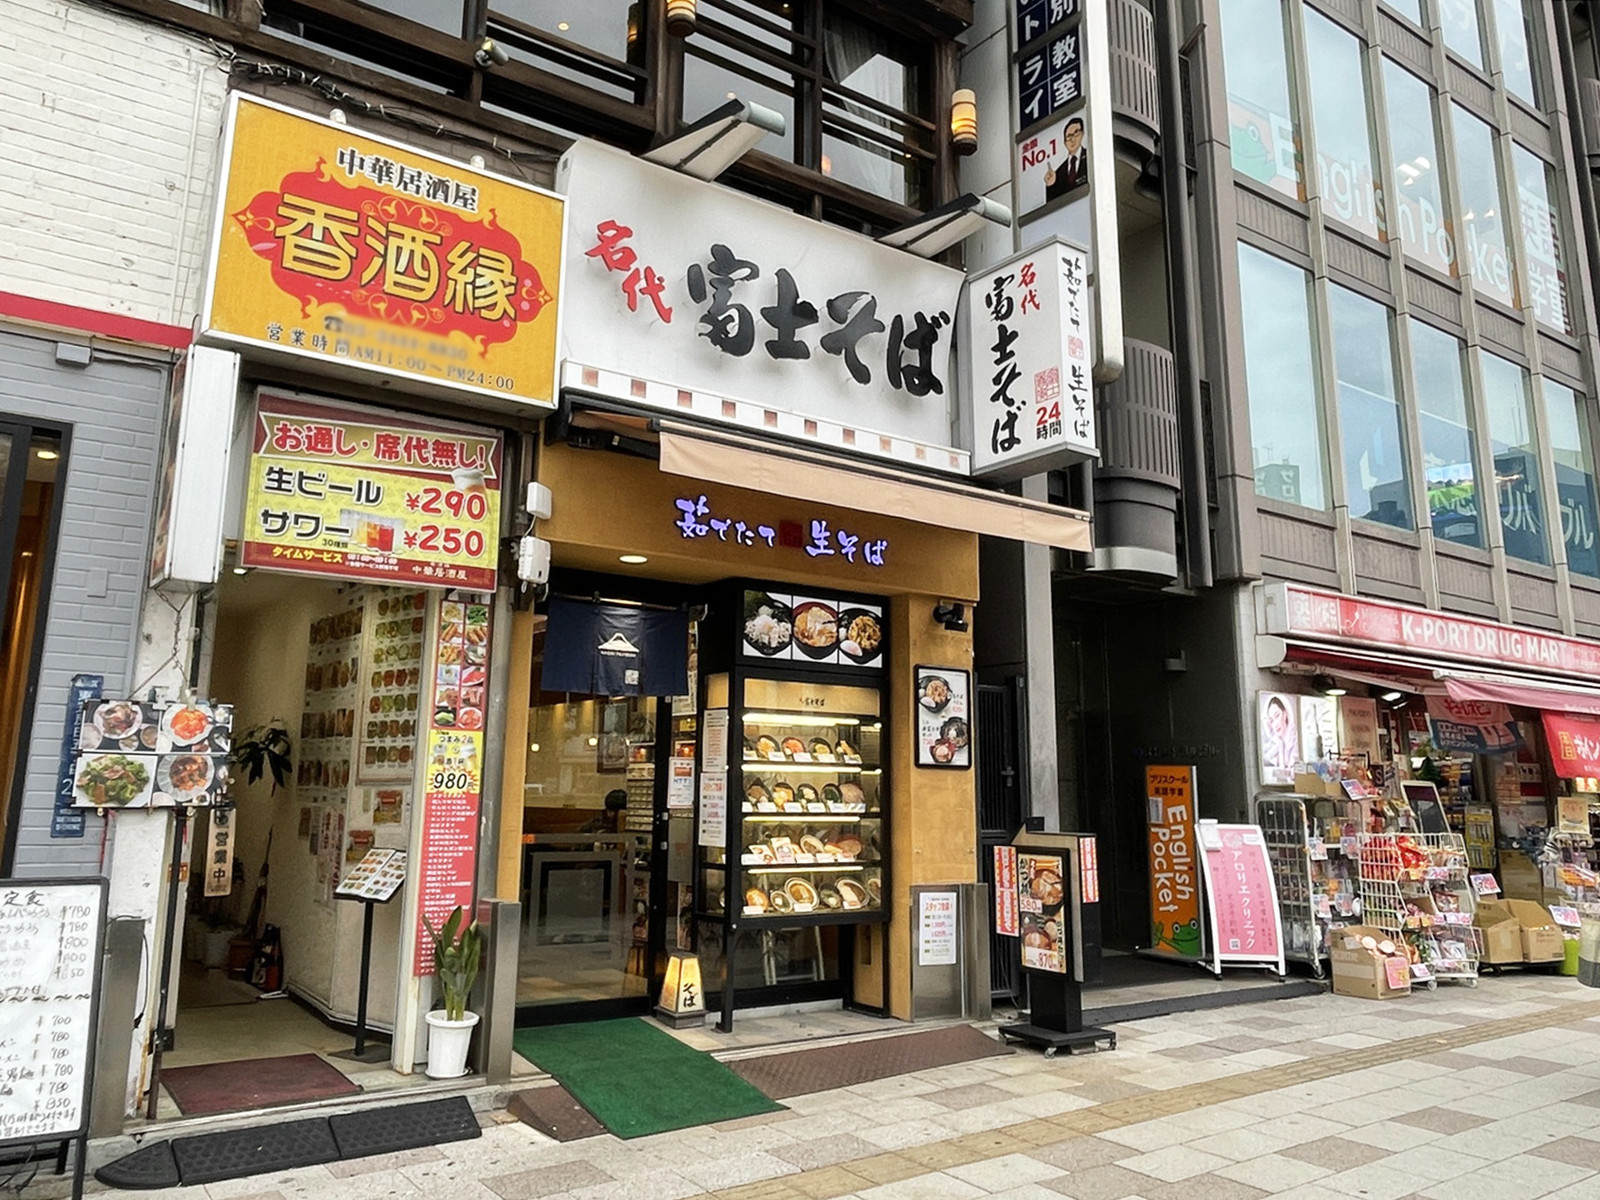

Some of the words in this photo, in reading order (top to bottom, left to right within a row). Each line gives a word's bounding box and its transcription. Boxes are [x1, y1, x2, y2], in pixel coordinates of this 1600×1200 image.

[1022, 0, 1043, 119] トライ
[1022, 139, 1056, 171] No.1
[337, 147, 480, 213] 中華居酒屋
[274, 193, 518, 321] 香酒縁
[584, 219, 673, 324] 名代
[686, 243, 951, 397] 富士そば
[1018, 262, 1041, 315] 名代
[985, 274, 1027, 455] 富士そば
[1036, 401, 1061, 427] 24
[1068, 364, 1090, 439] 生そば
[1036, 419, 1062, 440] 時間
[263, 465, 384, 507] 生ビール
[405, 487, 487, 522] ¥290
[260, 508, 352, 540] サワー
[403, 523, 485, 558] ¥250
[806, 520, 887, 565] 生そば
[271, 547, 344, 564] タイムサービス
[1401, 613, 1470, 649] K-PORT
[1474, 627, 1521, 659] DRUG
[1526, 636, 1567, 663] MART
[1151, 826, 1178, 912] Pocket
[1167, 805, 1194, 901] English
[683, 982, 698, 1008] そば
